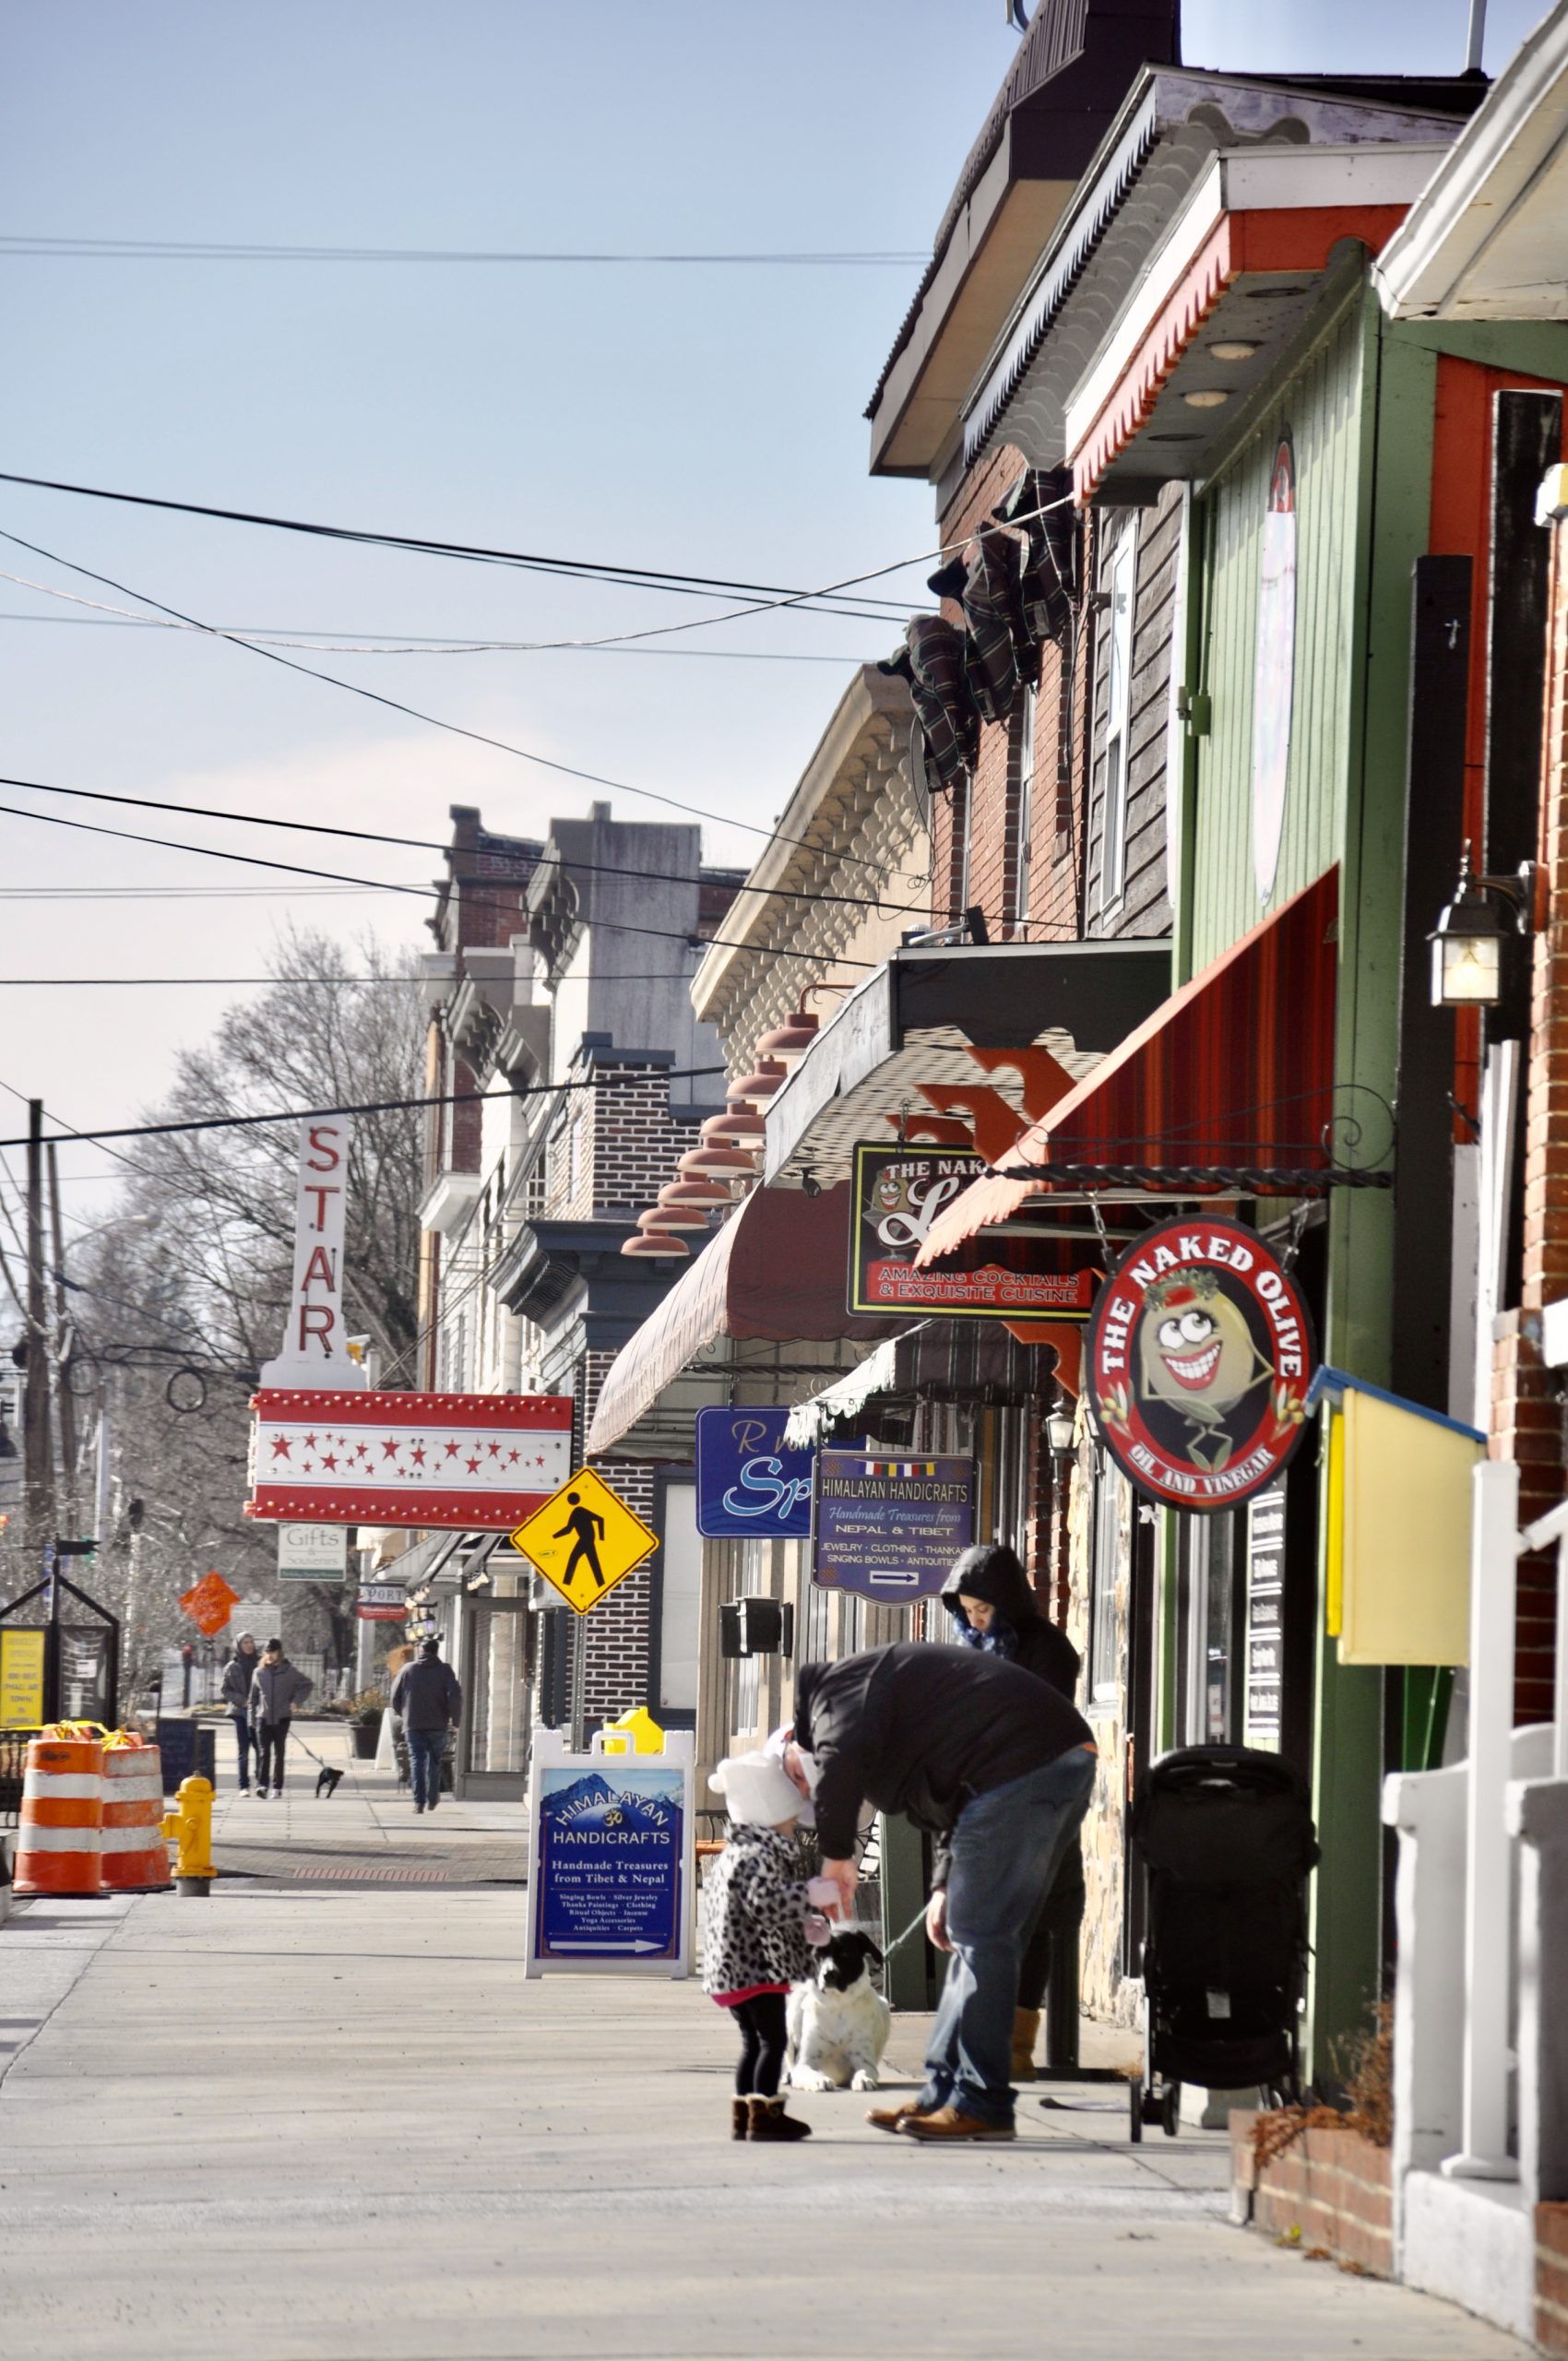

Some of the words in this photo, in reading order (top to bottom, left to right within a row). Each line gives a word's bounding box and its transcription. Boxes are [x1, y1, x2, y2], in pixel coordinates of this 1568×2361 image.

[885, 1160, 930, 1180] THE
[938, 1159, 986, 1175] NAK
[298, 1125, 340, 1353] STAR
[878, 1267, 968, 1284] AMAZING
[973, 1270, 1079, 1287] COCKTAILS
[879, 1284, 893, 1297] &
[897, 1284, 996, 1300] EXQUISITE
[1002, 1287, 1078, 1303] CUISINE
[1102, 1297, 1136, 1375] THE
[1128, 1235, 1254, 1290] NAKED
[1255, 1269, 1302, 1378] OLIVE
[1129, 1443, 1155, 1476] OIL
[1159, 1468, 1197, 1494] AND
[1204, 1446, 1277, 1495] VINEGAR
[722, 1455, 813, 1520] Sp
[822, 1477, 886, 1500] HIMALAYAN
[890, 1481, 968, 1503] HANDICRAFTS
[828, 1504, 885, 1522] Handmade
[888, 1508, 935, 1523] Treasures
[935, 1507, 962, 1526] from
[287, 1526, 339, 1547] Gifts
[835, 1524, 888, 1536] NEPAL
[891, 1525, 905, 1536] &
[909, 1526, 955, 1537] TIBET
[821, 1541, 863, 1552] JEWELRY
[871, 1543, 917, 1553] CLOTHING
[826, 1554, 863, 1564] SINGING
[864, 1555, 899, 1565] BOWLS
[554, 1790, 670, 1827] HIMALAYAN
[553, 1831, 671, 1845] HANDICRAFTS
[552, 1860, 612, 1870] Handmade
[616, 1860, 669, 1871] Treasures
[554, 1873, 581, 1883] from
[586, 1873, 614, 1884] Tibet
[618, 1874, 628, 1883] &
[633, 1874, 665, 1887] Nepal
[559, 1893, 586, 1902] Singing
[581, 1916, 599, 1925] Yoga
[600, 1916, 636, 1925] Accessories
[591, 1909, 616, 1917] Objects
[573, 1925, 611, 1933] Antiquities
